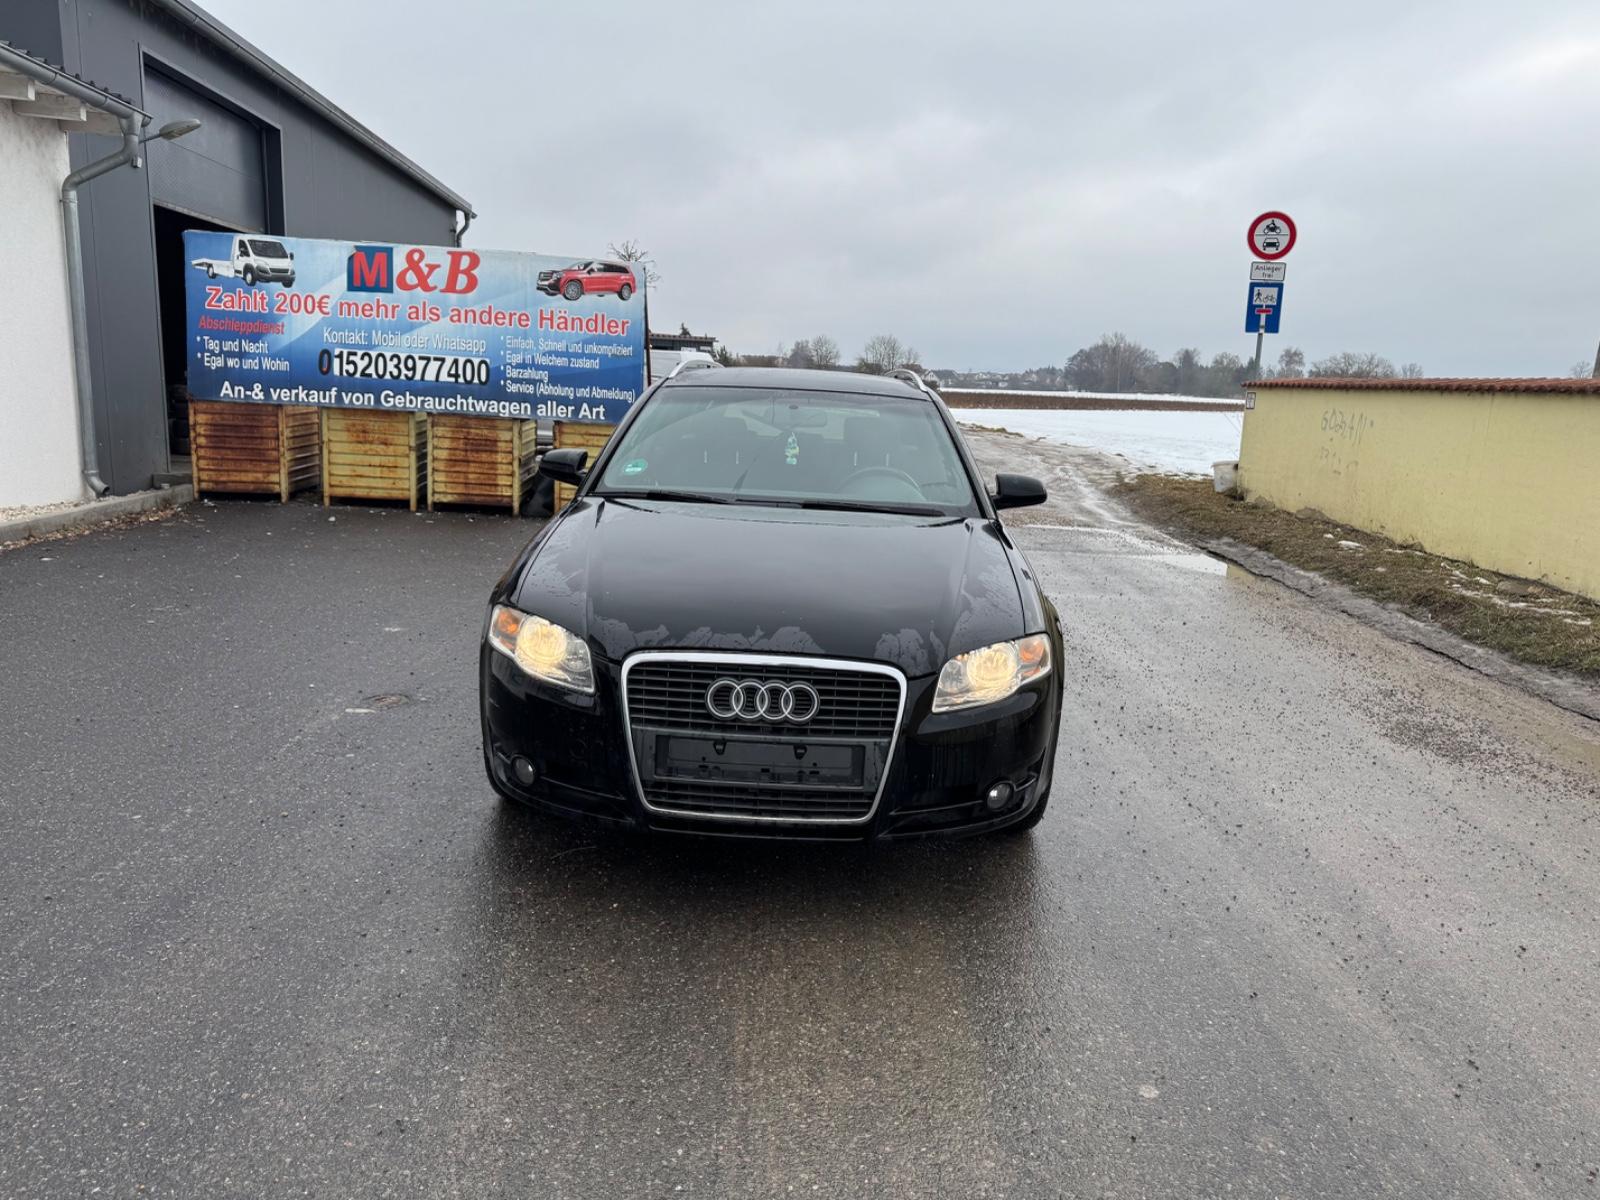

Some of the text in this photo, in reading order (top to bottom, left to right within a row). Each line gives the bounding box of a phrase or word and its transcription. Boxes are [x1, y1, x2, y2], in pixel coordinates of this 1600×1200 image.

[205, 287, 630, 337] Zahlt 200€ mehr als andere Händler
[199, 315, 285, 335] Abschleppdienst
[203, 336, 268, 354] Tag und Nacht
[323, 327, 486, 353] Kontakt: Mobil oder Whatsapp
[538, 337, 567, 353] Schnell
[569, 341, 583, 354] und
[584, 342, 632, 358] unkompliziert
[204, 353, 290, 372] Egal wo und Wohin
[318, 348, 490, 386] 015203977400
[505, 350, 600, 370] Egal in Welchem zustand
[505, 366, 549, 383] Barzahlung
[270, 385, 337, 403] verkauf
[342, 391, 374, 406] von
[380, 389, 531, 417] Gebrauchtwagen
[536, 400, 575, 417] aller
[578, 403, 606, 420] Art
[505, 380, 636, 404] Service (Abholung und Abmeldung)
